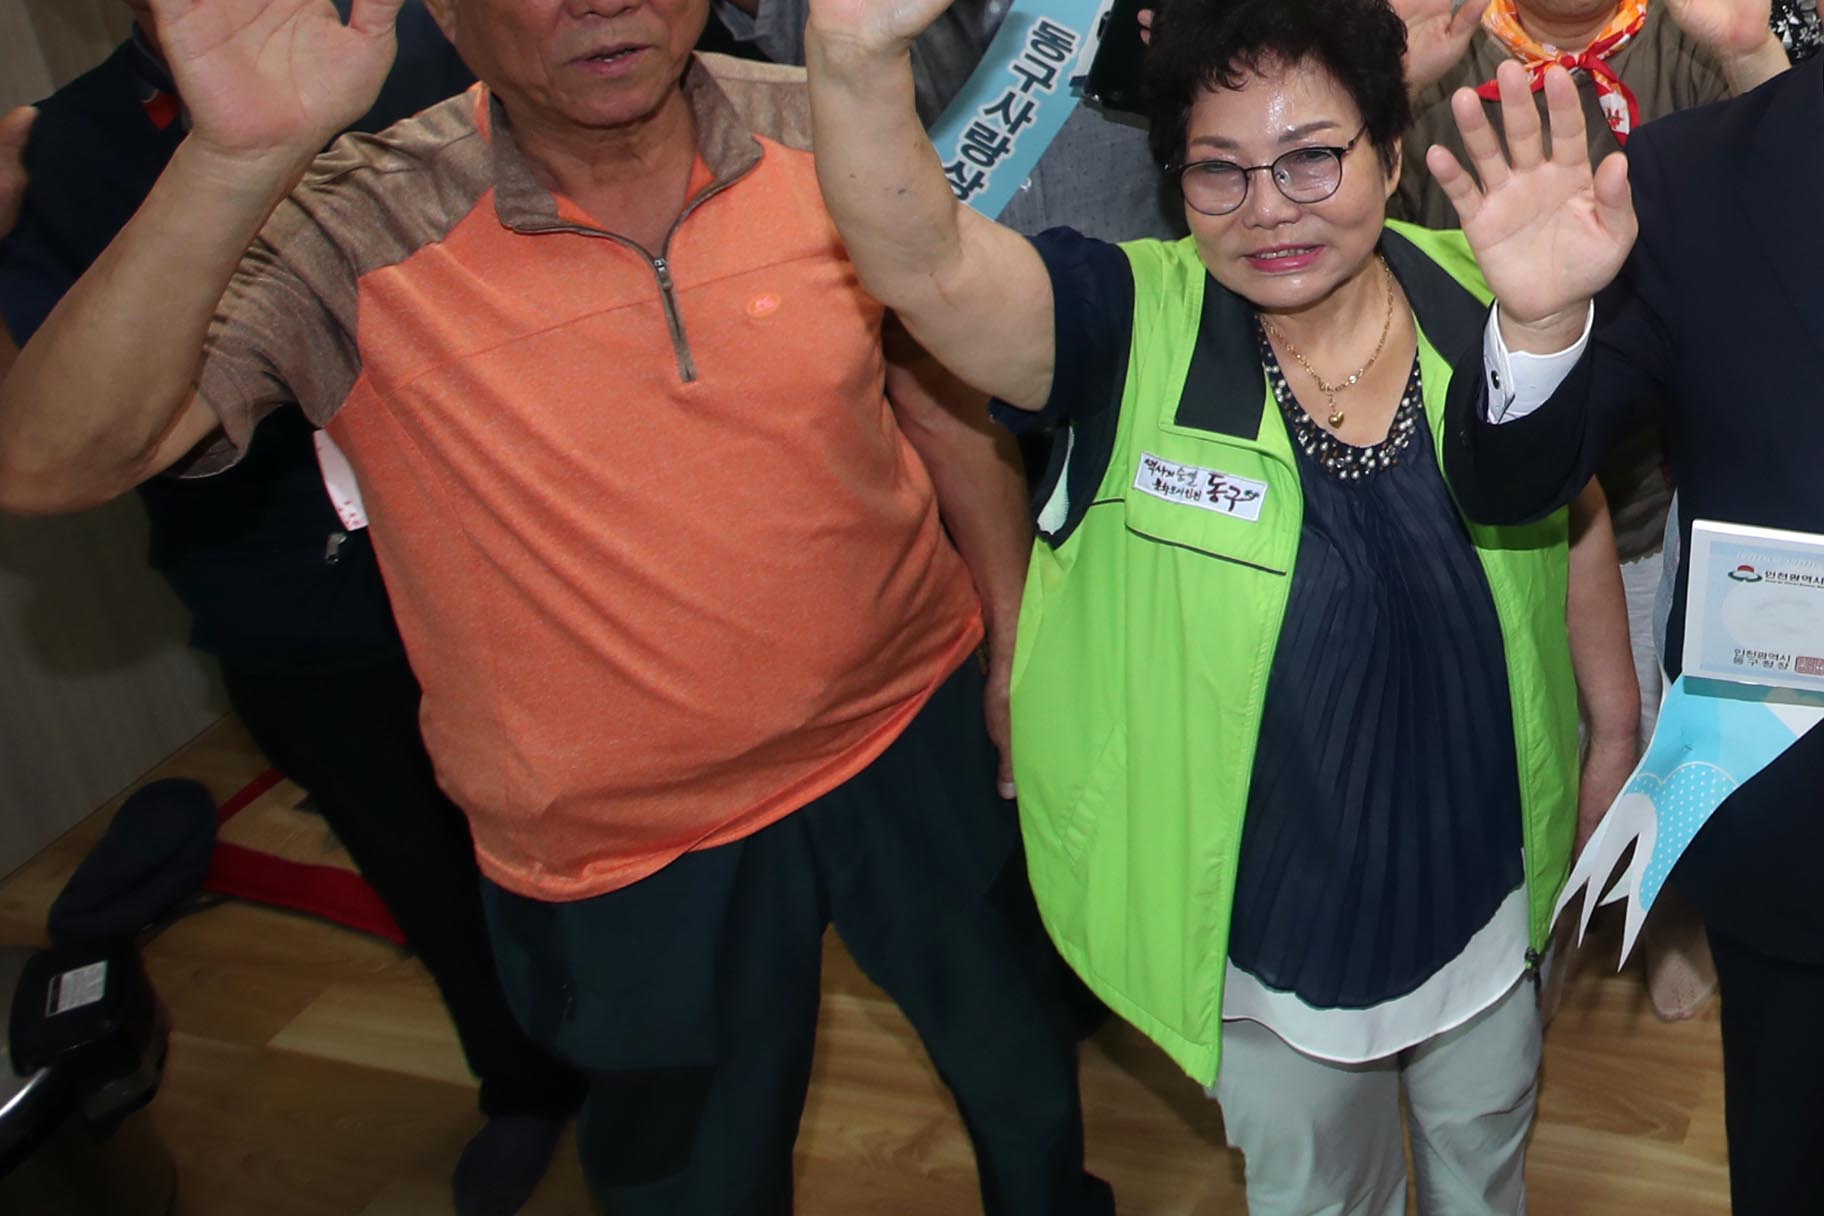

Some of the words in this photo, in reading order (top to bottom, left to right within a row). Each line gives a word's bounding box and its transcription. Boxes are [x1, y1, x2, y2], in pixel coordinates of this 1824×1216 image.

[945, 19, 1077, 201] 동구사랑상
[1206, 472, 1259, 513] 동구
[1764, 569, 1824, 586] 인천광역시
[1733, 648, 1792, 663] 인천광역시
